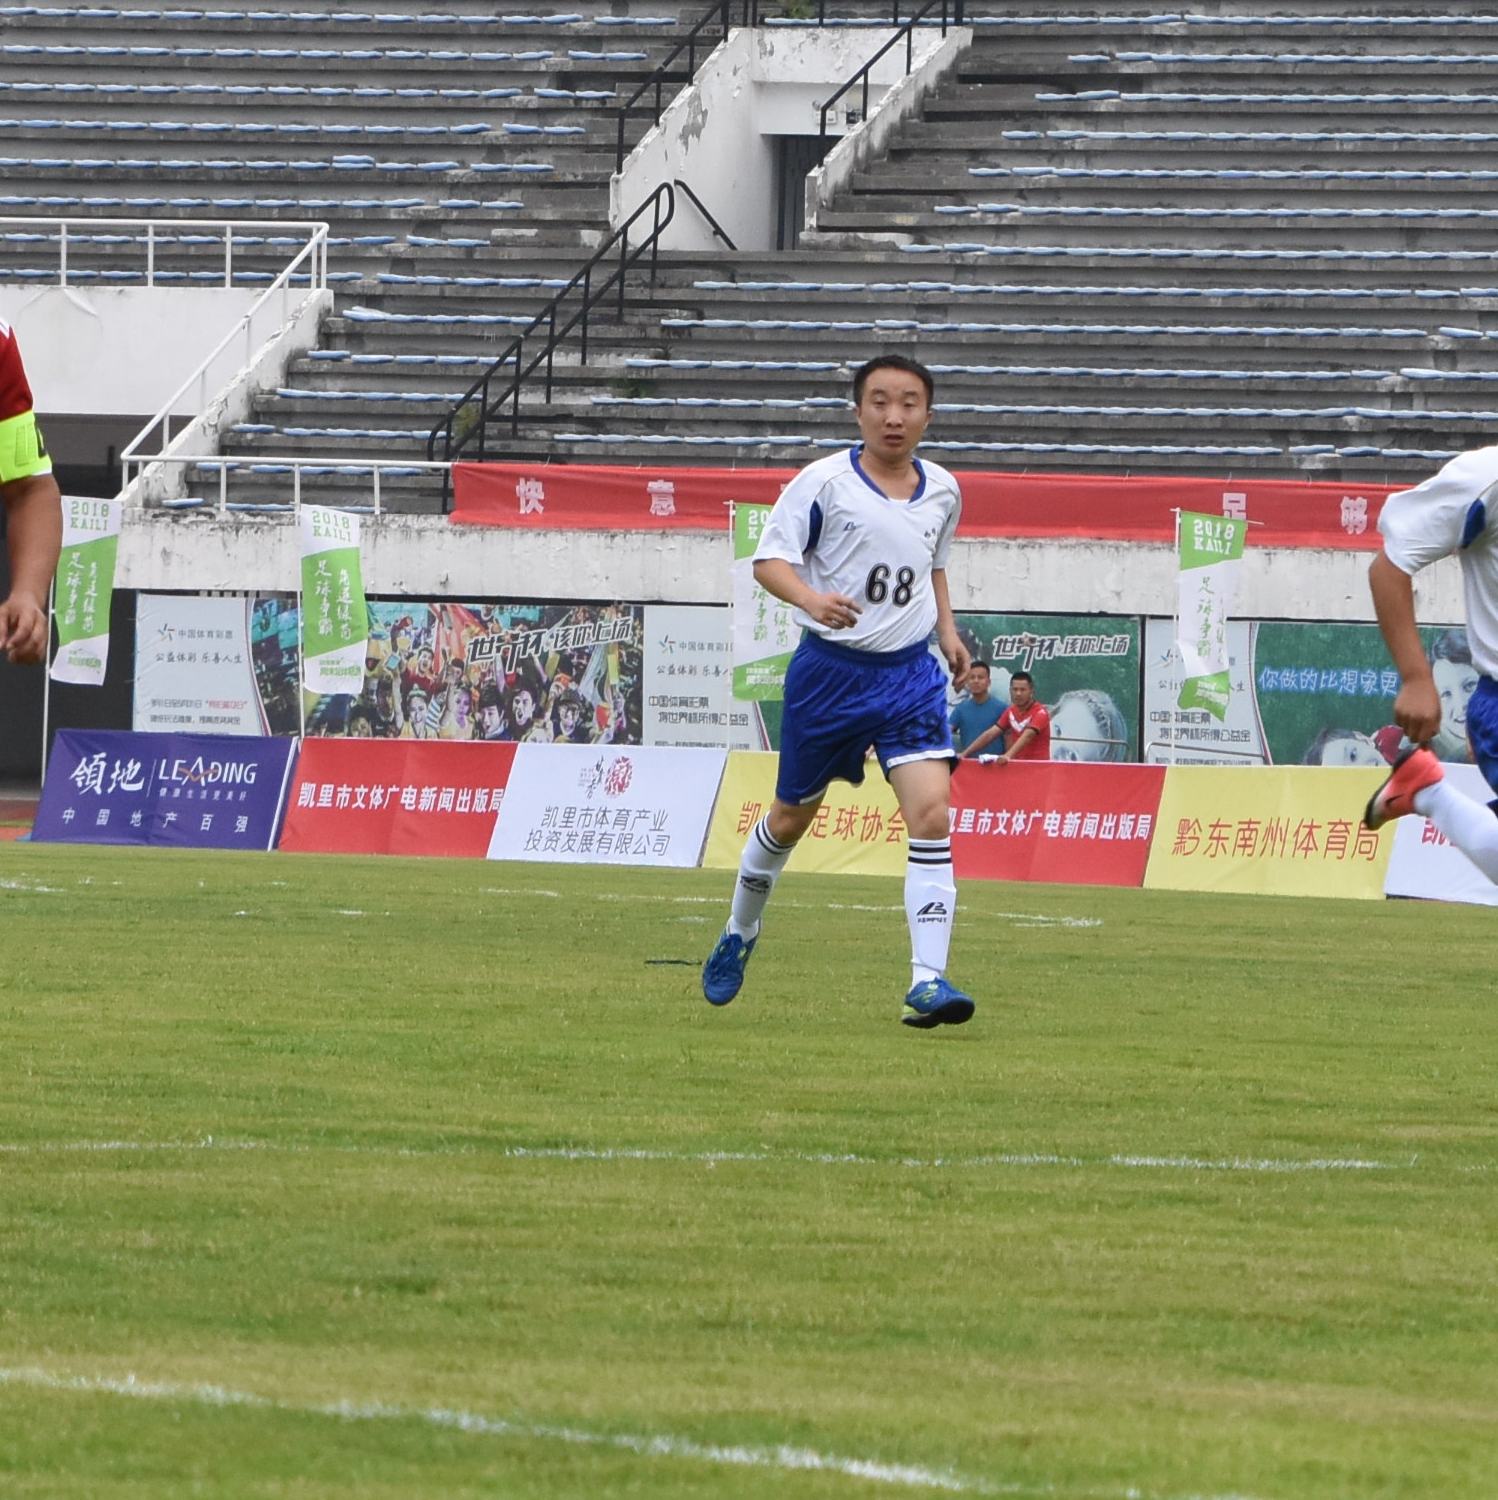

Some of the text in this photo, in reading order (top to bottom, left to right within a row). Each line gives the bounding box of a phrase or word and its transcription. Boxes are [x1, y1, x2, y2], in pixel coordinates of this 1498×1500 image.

[71, 501, 109, 518] 2018
[312, 510, 350, 529] 2018
[70, 517, 107, 531] KAILI
[313, 526, 351, 542] KAILI
[1194, 518, 1235, 539] 2018
[1194, 536, 1232, 555] KAILI
[314, 560, 333, 635] 足球争霸
[865, 563, 916, 608] 68
[1197, 576, 1215, 658] 足球争霸
[178, 629, 233, 639] 中国体育彩票
[155, 652, 243, 664] 公益体彩 乐善人生
[159, 756, 259, 786] LEADING
[297, 781, 504, 814] 凯里市文体广电新闻出版局
[62, 807, 249, 833] 中国地产百强
[540, 806, 669, 833] 凯里市体育产业
[737, 801, 906, 844] 凯足球协会
[523, 830, 671, 858] 投资发展有限公司
[1172, 817, 1380, 862] 黔东南州体育局
